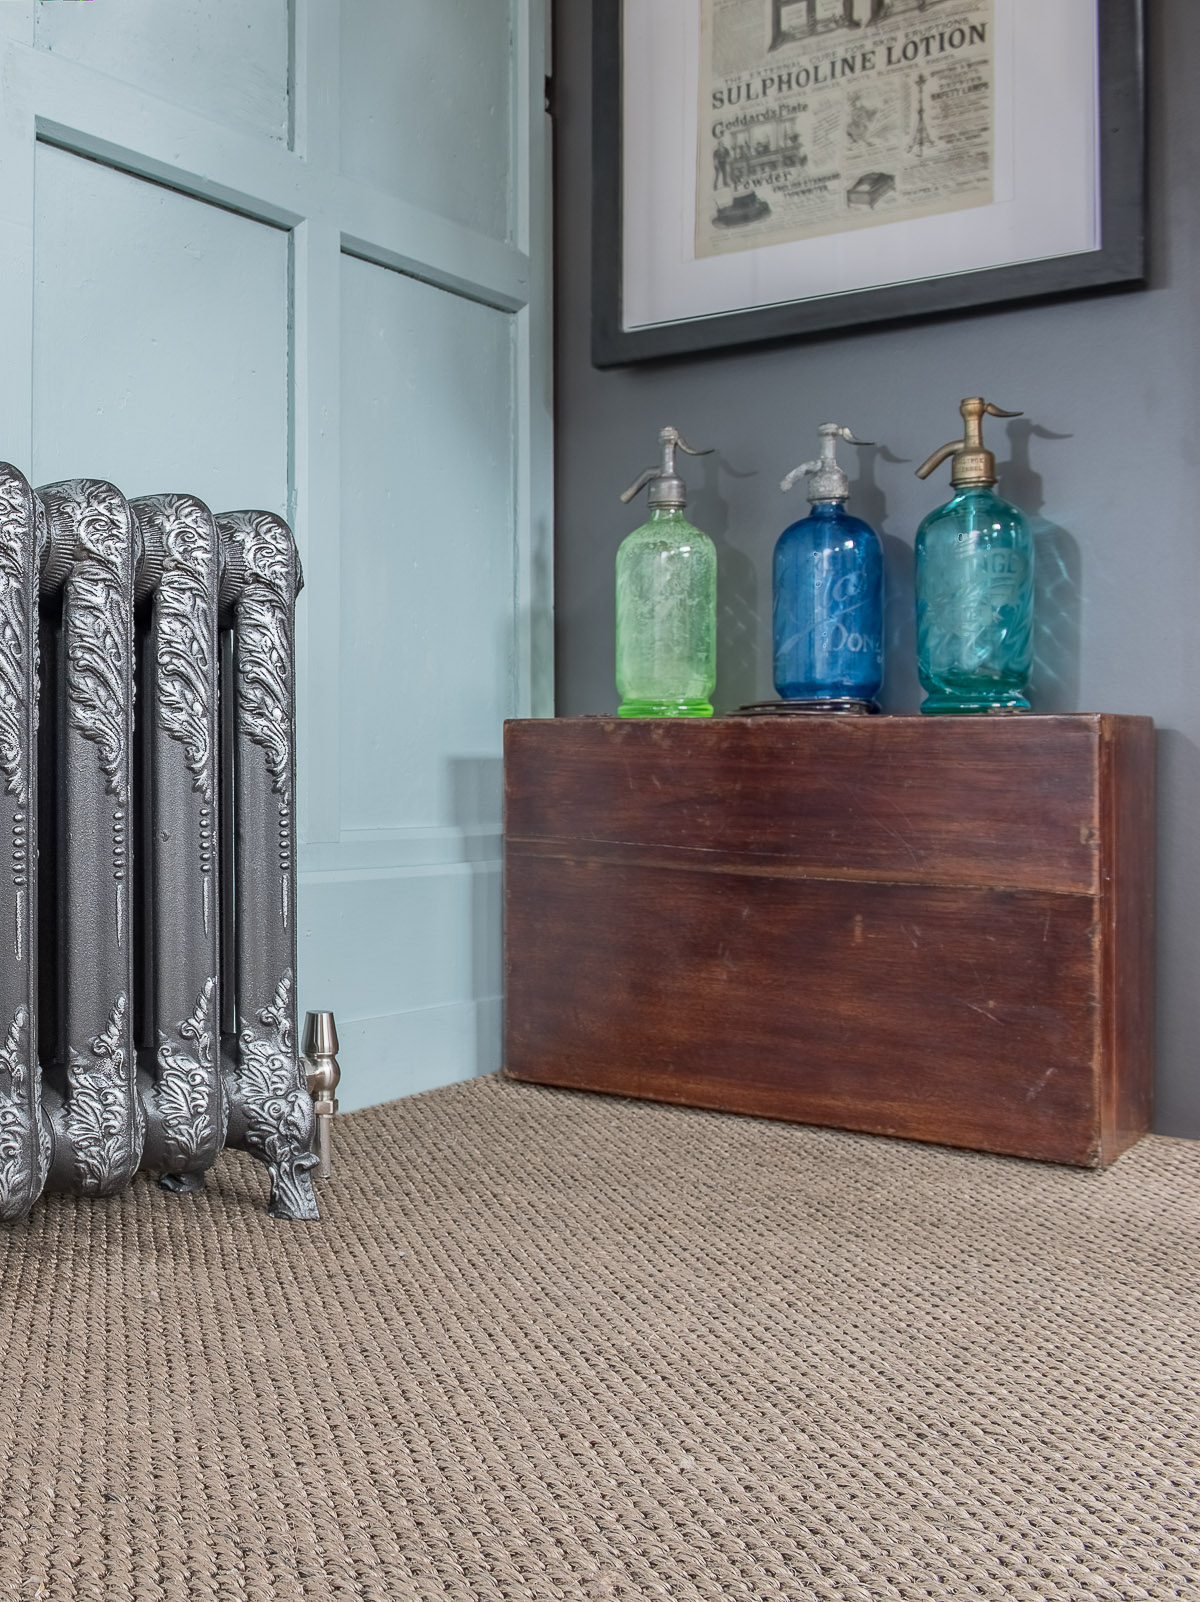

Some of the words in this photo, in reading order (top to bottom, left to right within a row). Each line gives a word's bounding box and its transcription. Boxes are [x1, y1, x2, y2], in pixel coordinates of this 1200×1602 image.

[712, 50, 876, 110] SULPHOLINE
[886, 22, 988, 66] LOTION
[725, 74, 742, 86] THE
[809, 49, 839, 64] CURE
[845, 43, 866, 55] FOR
[872, 35, 898, 47] SKIN
[712, 108, 778, 139] Goddard's
[779, 102, 809, 119] Plate
[734, 170, 793, 192] Powder
